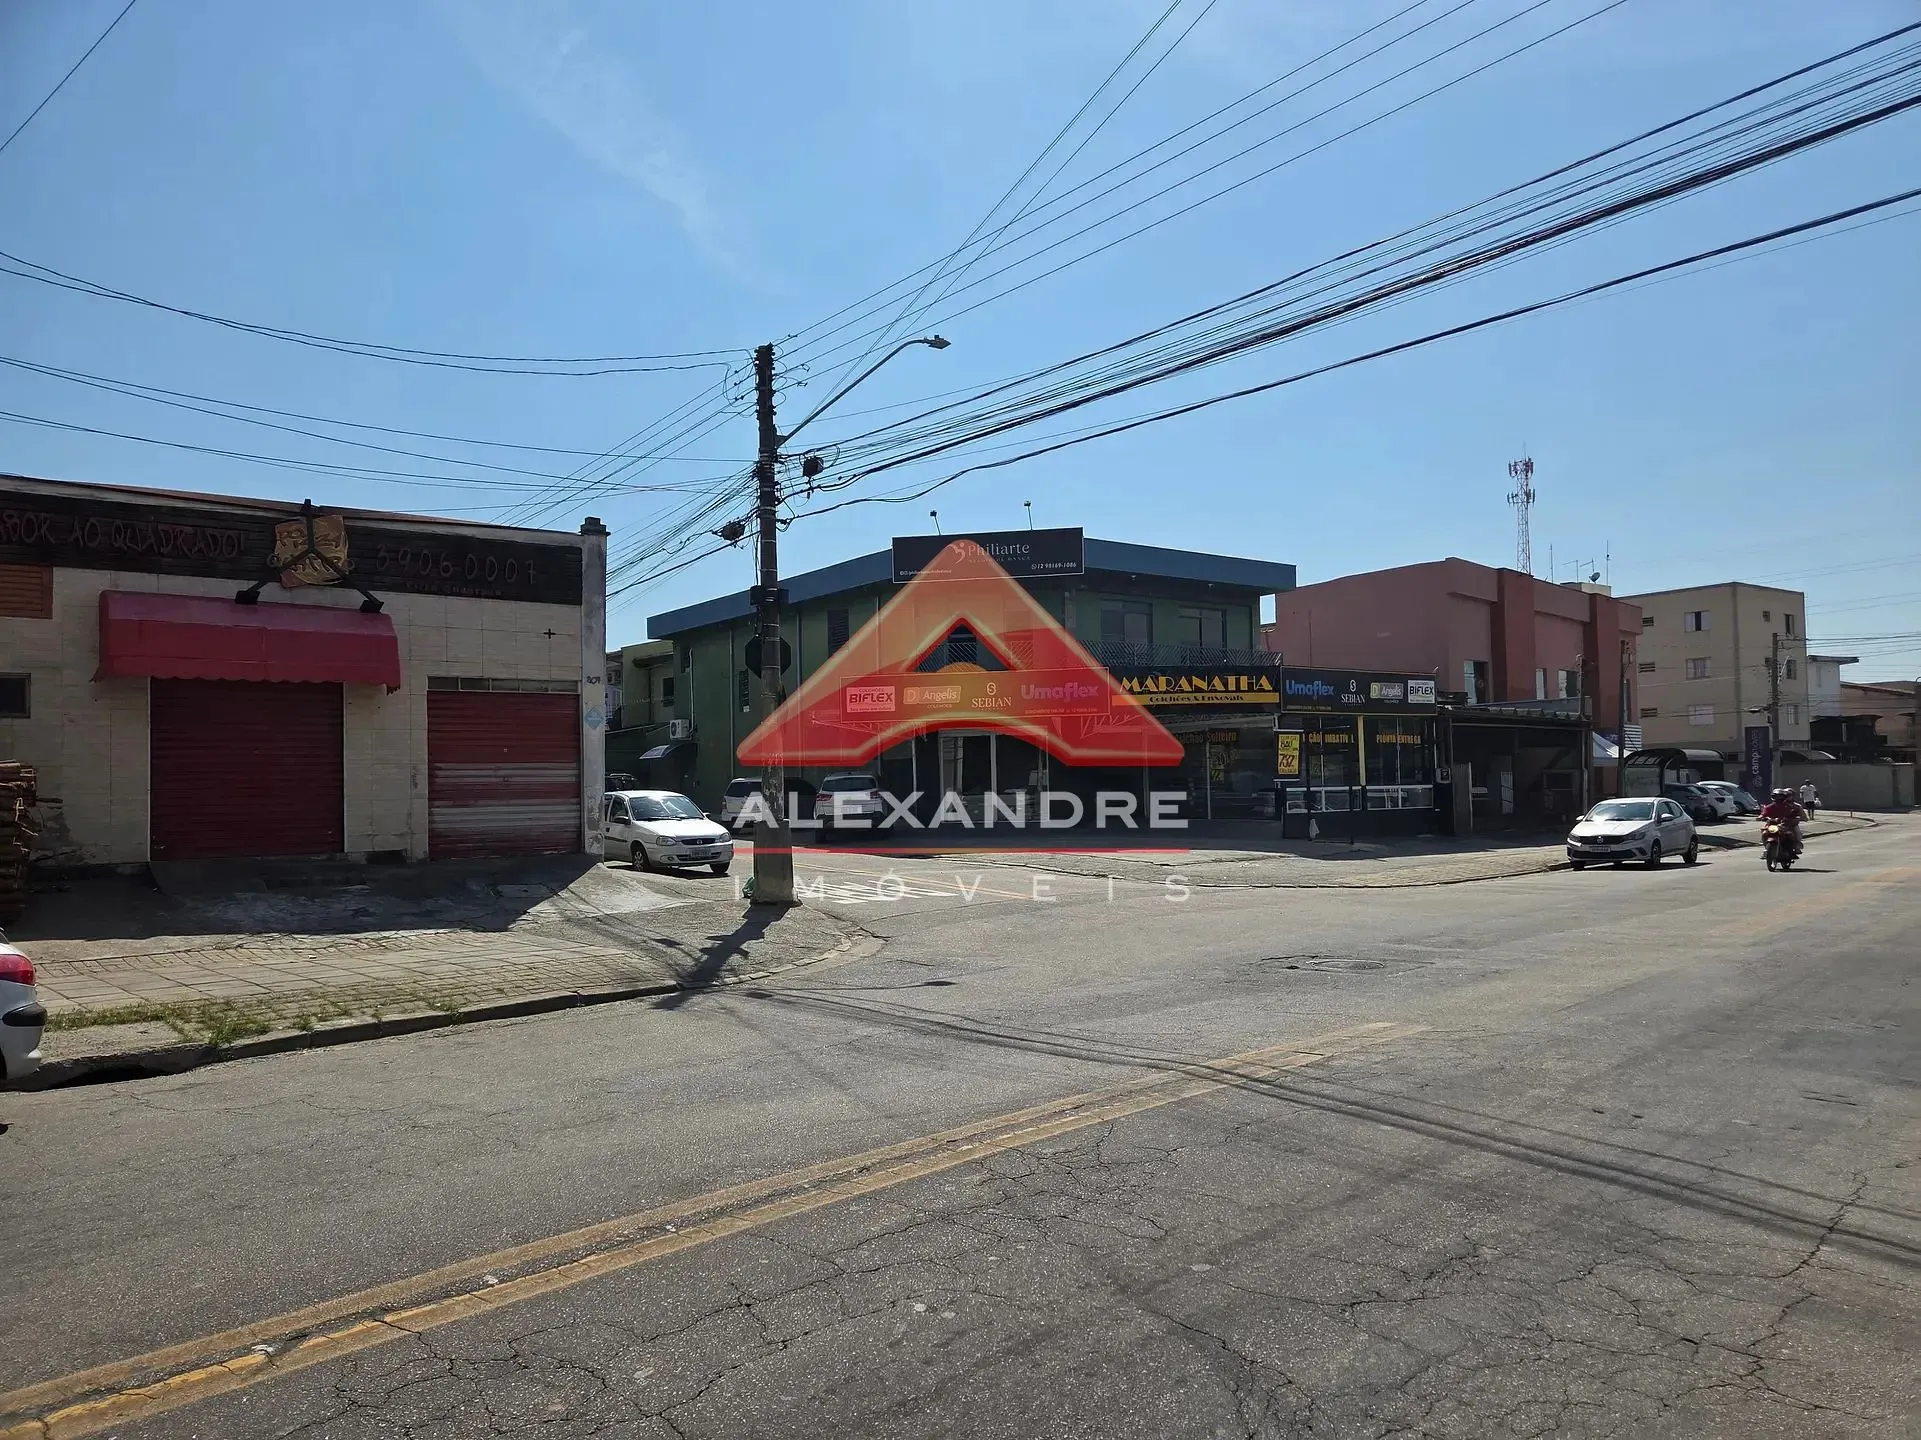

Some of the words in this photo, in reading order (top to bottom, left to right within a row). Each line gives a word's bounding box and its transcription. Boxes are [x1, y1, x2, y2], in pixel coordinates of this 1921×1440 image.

[968, 543, 1031, 556] Philiarte
[1120, 675, 1273, 692] MARANATHA
[1021, 682, 1099, 701] Umaflex
[1285, 680, 1335, 700] Umaflex
[1409, 685, 1434, 696] BIFLEX
[849, 692, 893, 704] BIFLEX
[971, 697, 1012, 708] SEBIAN
[1340, 693, 1366, 703] SEBIAN
